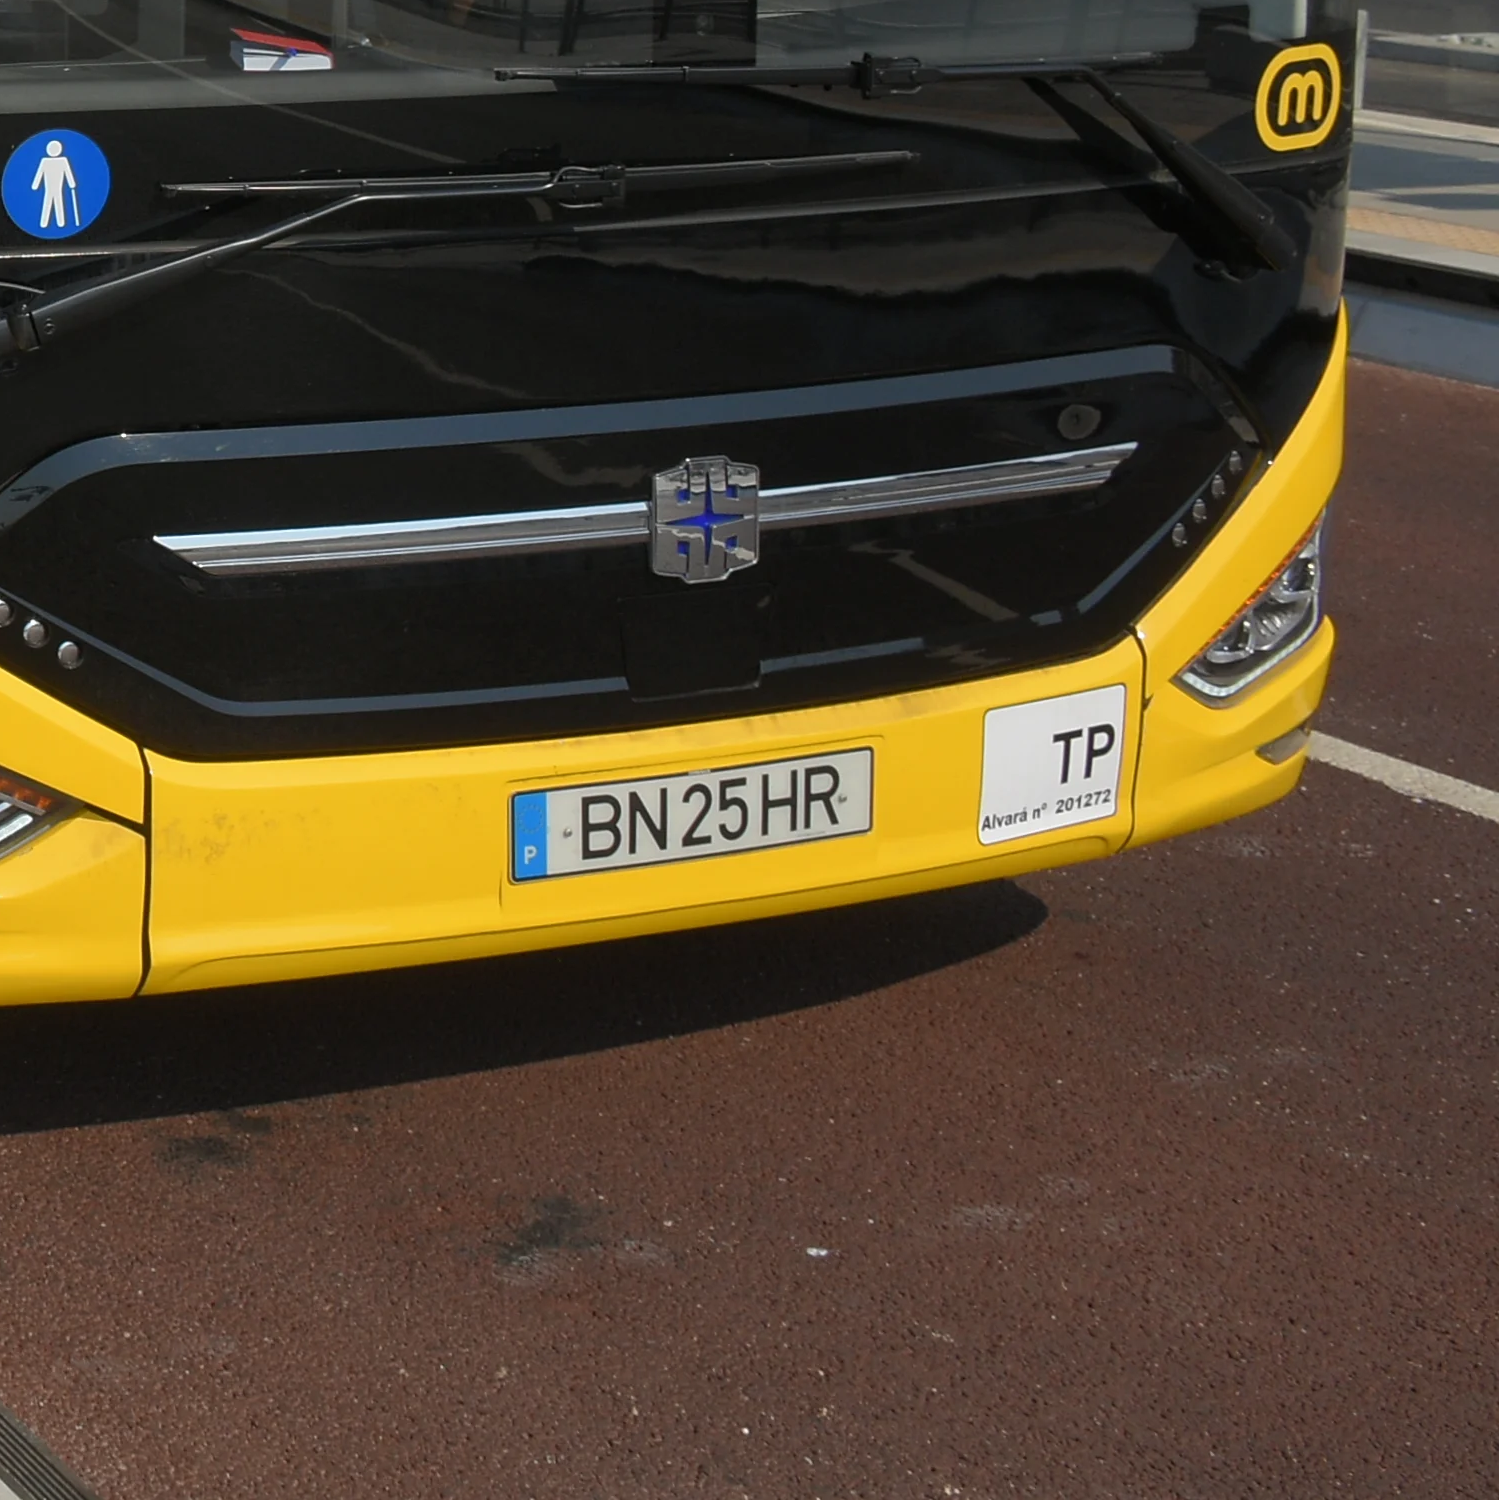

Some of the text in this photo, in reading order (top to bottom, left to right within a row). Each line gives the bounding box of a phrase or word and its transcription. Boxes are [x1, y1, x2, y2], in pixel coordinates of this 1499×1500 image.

[1052, 722, 1116, 785] TP
[980, 806, 1029, 832] Alvará
[1054, 788, 1112, 815] 201272
[523, 844, 538, 865] P
